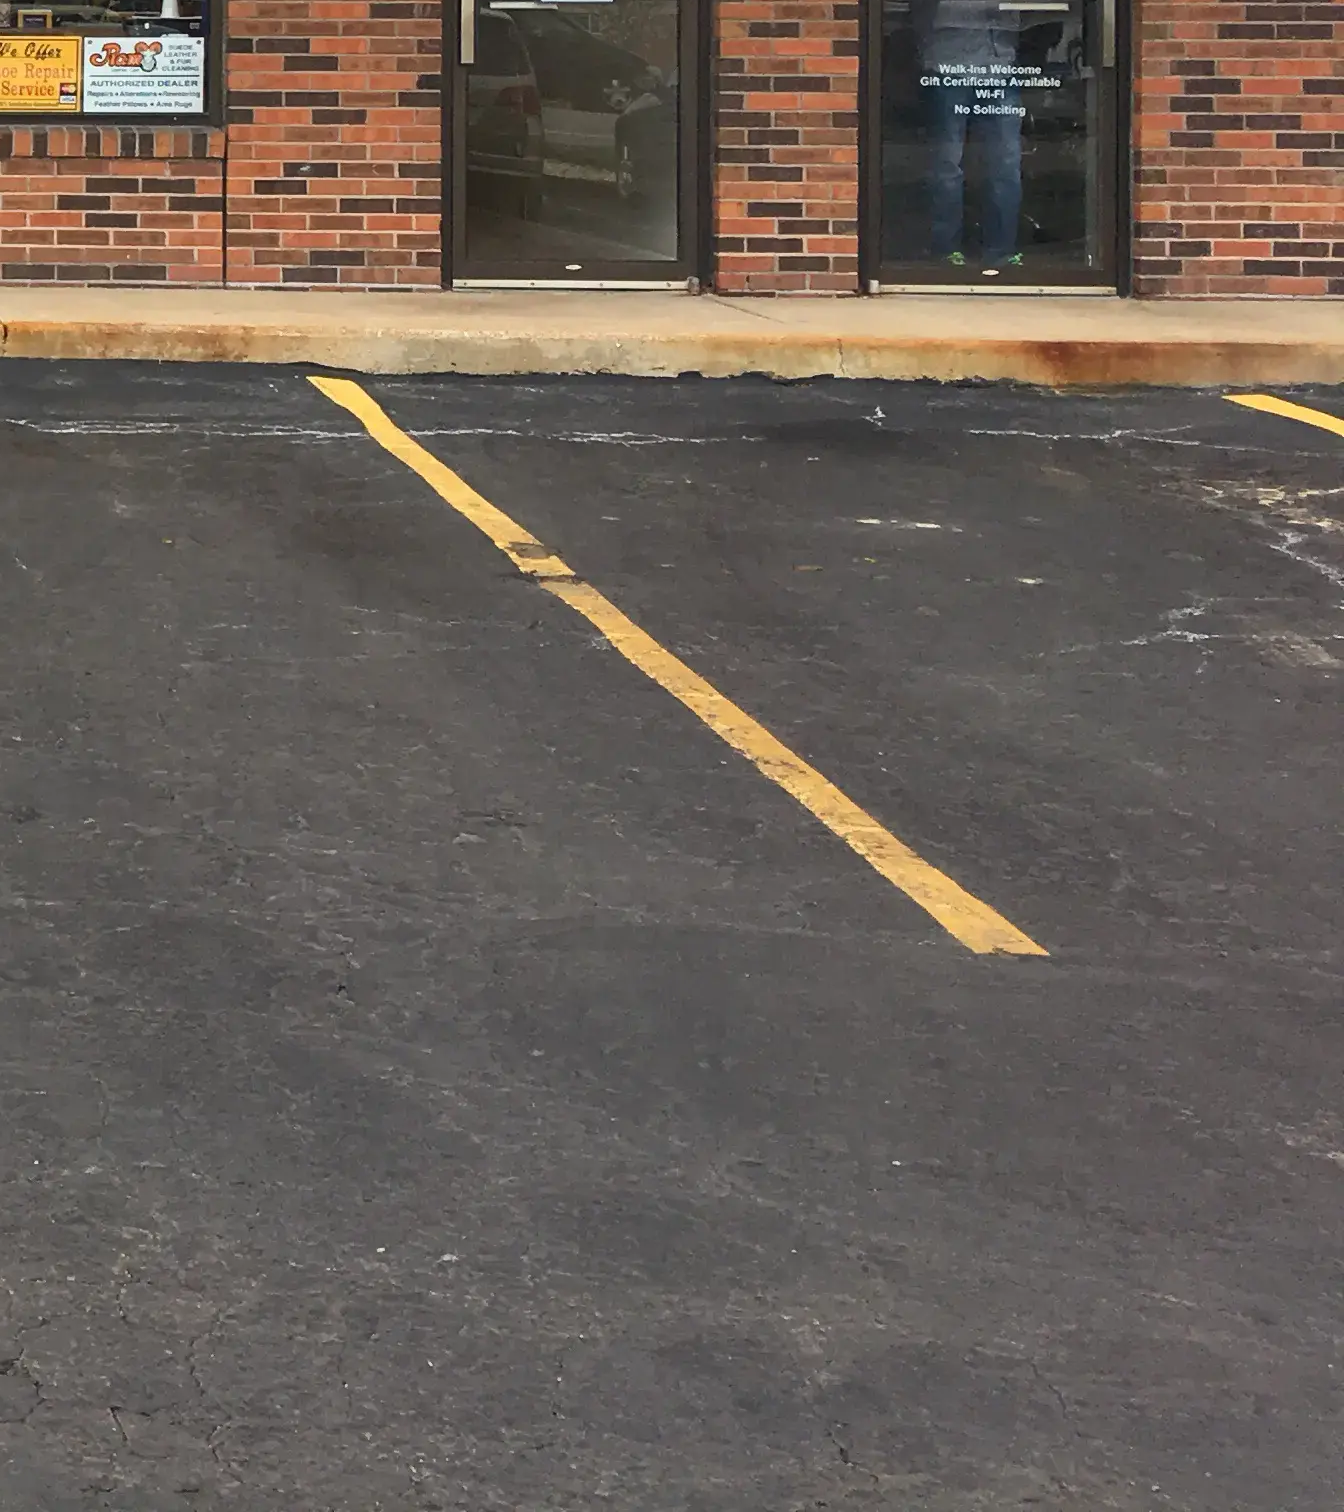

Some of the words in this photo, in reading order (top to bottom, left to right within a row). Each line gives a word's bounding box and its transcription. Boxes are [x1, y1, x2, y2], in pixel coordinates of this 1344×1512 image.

[24, 41, 62, 61] Offer
[24, 62, 74, 83] Repair
[938, 64, 987, 75] Walk-Ins
[990, 64, 1042, 75] Welcome
[90, 80, 154, 88] AUTHORIZED
[920, 76, 941, 87] Gift
[942, 76, 1007, 87] Certificates
[1009, 76, 1062, 88] Available
[1, 80, 55, 97] Service
[975, 89, 1005, 99] Wi-Fi
[954, 104, 971, 115] No
[973, 104, 1027, 117] Soliciting
